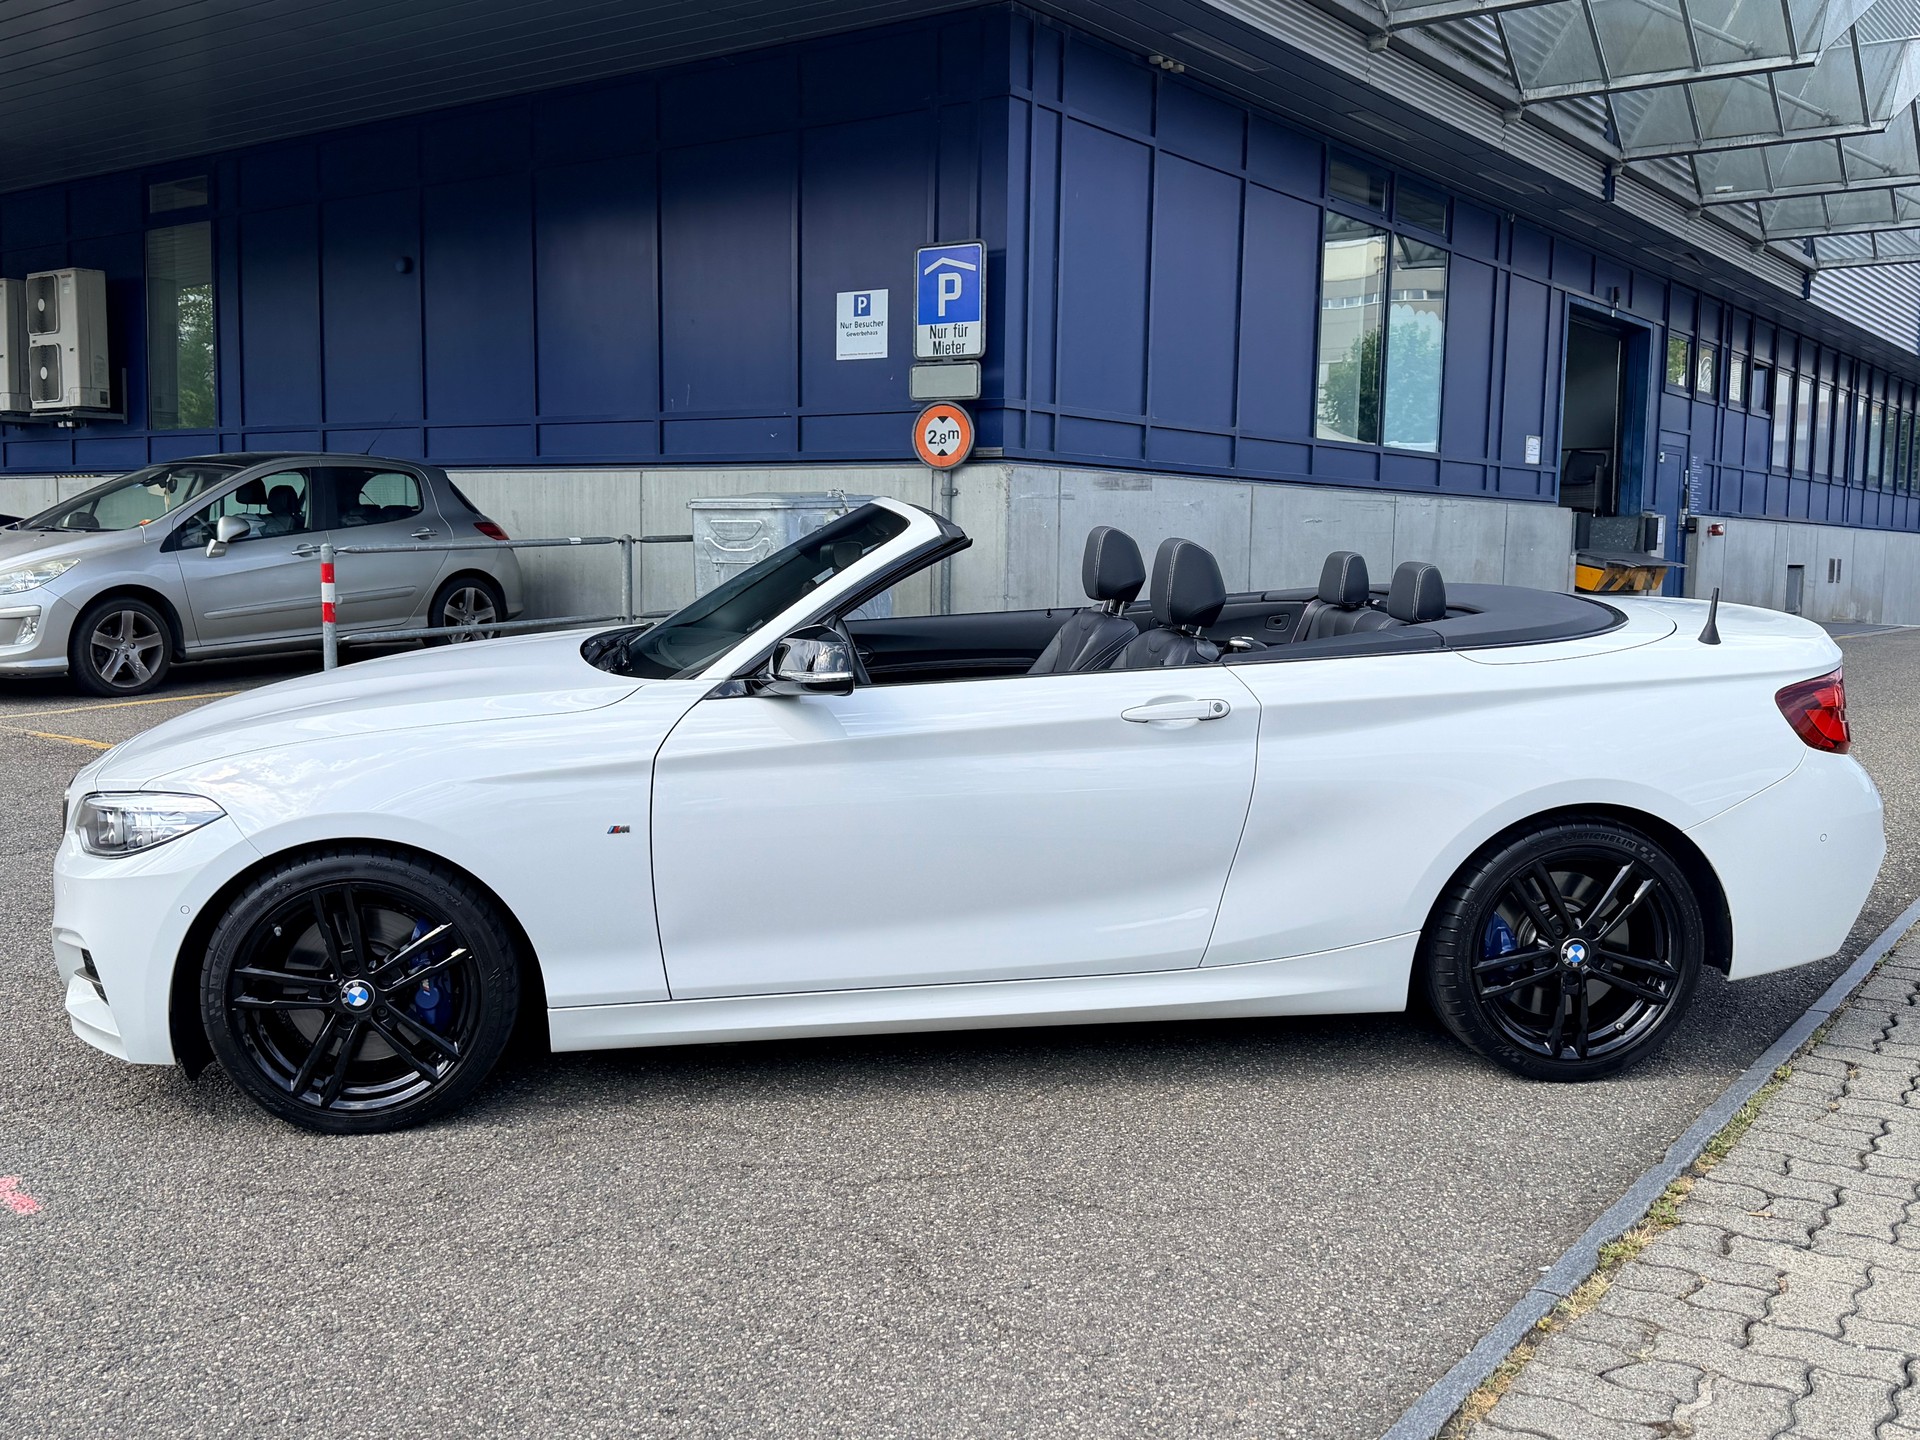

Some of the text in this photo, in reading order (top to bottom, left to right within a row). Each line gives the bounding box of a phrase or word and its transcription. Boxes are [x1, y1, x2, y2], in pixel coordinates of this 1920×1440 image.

[938, 272, 962, 317] P
[857, 296, 868, 315] P
[840, 320, 885, 329] Nur Besucher
[929, 323, 968, 339] Nur für
[932, 340, 966, 355] Mieter
[1575, 833, 1637, 850] MICHELIN
